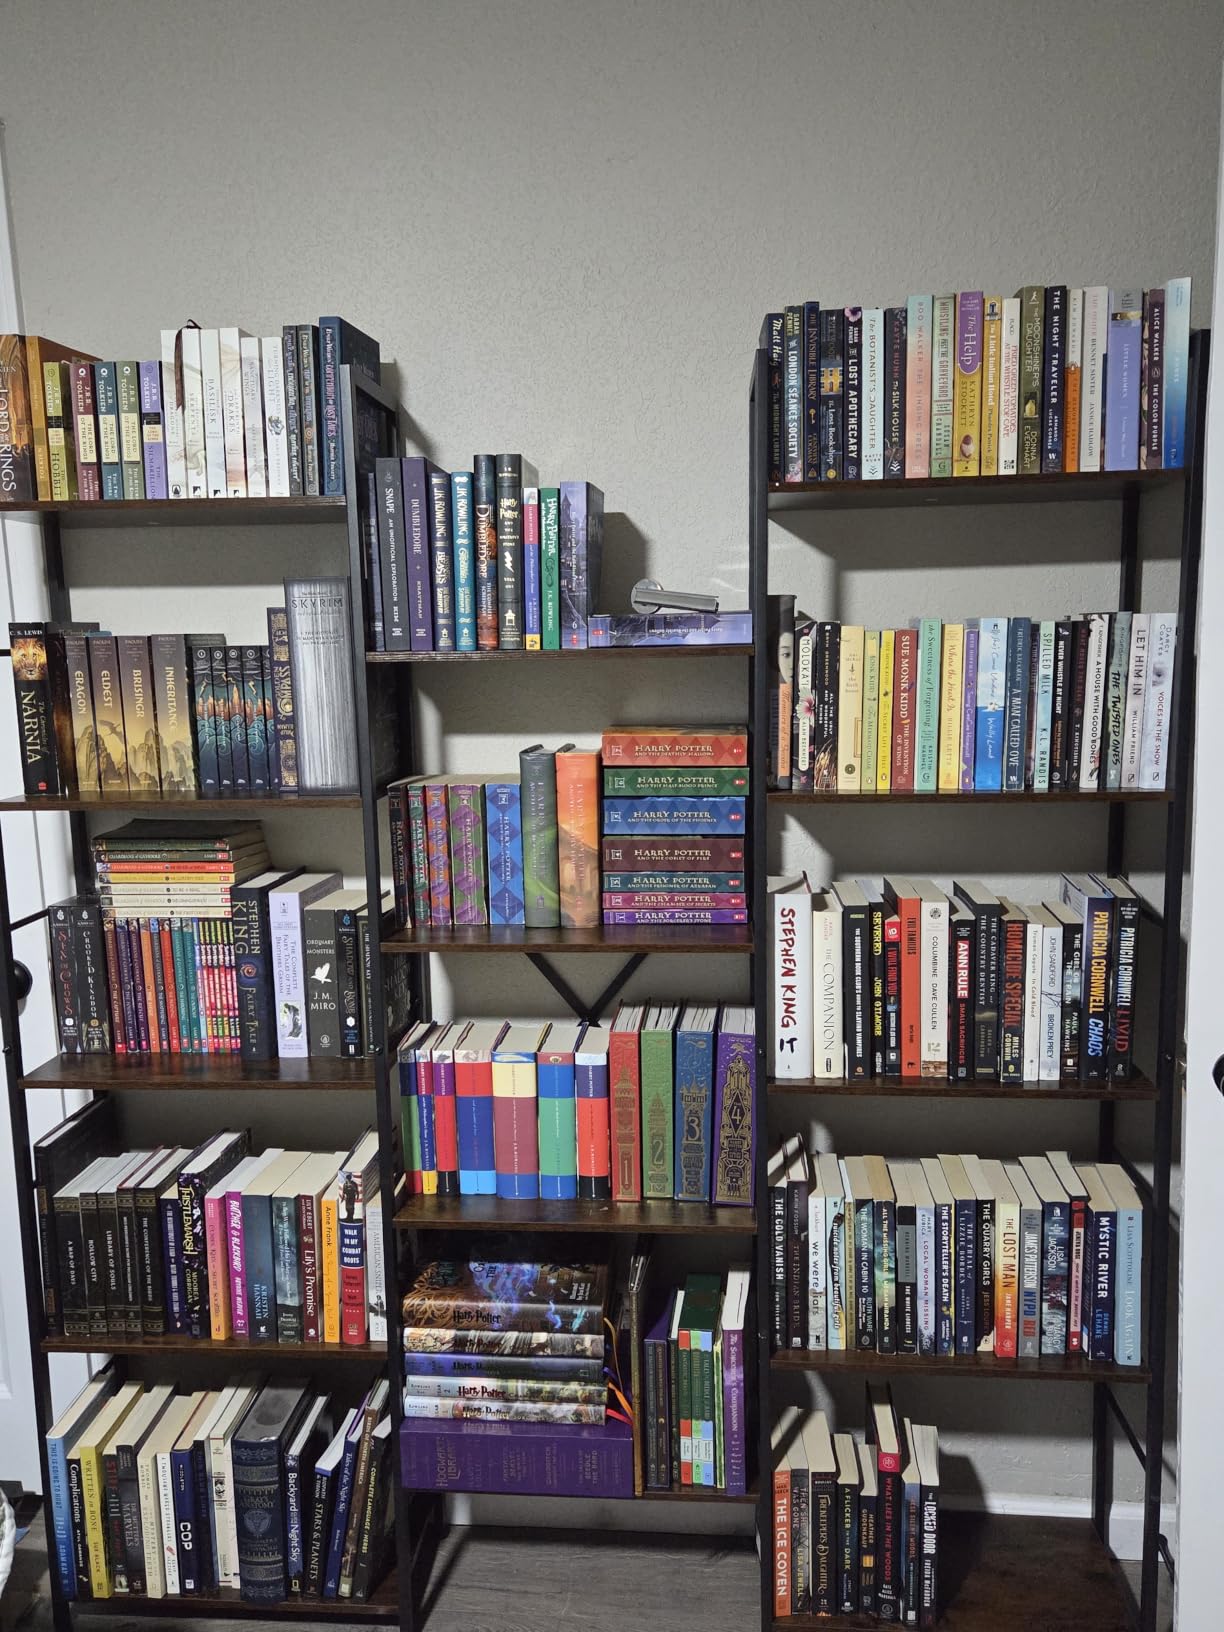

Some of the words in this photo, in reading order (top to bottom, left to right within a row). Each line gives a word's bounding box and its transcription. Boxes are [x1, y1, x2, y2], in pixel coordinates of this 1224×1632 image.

[773, 318, 782, 342] Matt
[967, 314, 976, 331] The
[808, 328, 818, 366] INVISIBLE
[961, 333, 976, 364] Help
[808, 369, 816, 400] LIBRARY
[849, 360, 857, 385] LOST
[789, 422, 797, 458] SOCIETY
[848, 390, 857, 458] APOTHECARY
[1, 444, 16, 491] RINGS
[52, 453, 62, 497] HOBBIT
[386, 488, 394, 513] SNAPE
[410, 499, 421, 554] DUMBLEDORE
[435, 500, 446, 536] ROWLING
[476, 504, 490, 578] DUMBLEDORE
[437, 551, 446, 584] BEASTS
[901, 636, 909, 656] SUE
[1043, 633, 1052, 669] SPILLED
[1136, 630, 1146, 650] LET
[1112, 671, 1120, 689] THE
[1134, 656, 1144, 678] HIM
[75, 670, 87, 714] ERAGON
[102, 670, 112, 708] ELDEST
[133, 670, 144, 718] BRISINGR
[1042, 674, 1051, 694] MILK
[1133, 684, 1142, 696] IN
[900, 692, 908, 718] KIDD
[1011, 697, 1021, 716] MAN
[1112, 694, 1121, 737] TWISTED
[22, 691, 40, 764] NARNIA
[1010, 719, 1020, 748] CALLED
[1009, 751, 1019, 766] OVE
[1038, 751, 1048, 784] RANDIS
[1112, 740, 1120, 765] ONES
[233, 901, 248, 954] KING
[249, 901, 260, 954] STEPHEN
[780, 908, 796, 977] STEPHEN
[873, 912, 882, 956] SEVERED
[1092, 912, 1108, 956] PATRICIA
[958, 942, 968, 968] ANN
[1006, 924, 1023, 978] HOMICIDE
[1119, 928, 1135, 963] PATRICIA
[958, 970, 968, 998] RULE
[1089, 958, 1106, 1014] CORNWELL
[1117, 966, 1132, 1006] CORNWELL
[240, 986, 255, 1016] FAIRY
[781, 984, 798, 1028] KING
[824, 963, 834, 1050] COMPANION
[1005, 982, 1022, 1028] SPECIAL
[246, 1020, 258, 1043] TALE
[1088, 1018, 1104, 1056] CHAOS
[1115, 1010, 1130, 1052] LIVID
[688, 1116, 701, 1140] 3
[654, 1140, 664, 1164] 2
[182, 1184, 198, 1254] THISTLEMARSH
[774, 1199, 783, 1216] THE
[775, 1219, 783, 1242] COLD
[1003, 1232, 1016, 1260] LOST
[1024, 1232, 1036, 1254] JAMES
[1100, 1217, 1110, 1258] MYSTIC
[302, 1250, 315, 1272] Lily's
[776, 1245, 784, 1280] VANISH
[812, 1242, 820, 1256] we
[1003, 1264, 1015, 1288] MAN
[1024, 1254, 1036, 1288] PATTERSON
[1098, 1263, 1108, 1298] RIVER
[254, 1284, 262, 1318] HANNAH
[306, 1276, 315, 1316] Promise
[1024, 1291, 1036, 1316] NYPD
[453, 1311, 474, 1322] Harry
[476, 1312, 500, 1323] Potter
[458, 1386, 480, 1396] Harry
[481, 1386, 506, 1398] Potter
[730, 1388, 738, 1431] COMPANION
[70, 1464, 82, 1522] Complications
[288, 1472, 298, 1512] Backyard
[314, 1502, 324, 1530] STARS
[776, 1498, 786, 1526] THE
[818, 1494, 830, 1542] FIREKEEPER'S
[924, 1502, 936, 1531] LOCKED
[181, 1522, 192, 1550] COP
[290, 1524, 298, 1546] Night
[777, 1528, 786, 1549] ICE
[924, 1533, 936, 1554] DOOR
[290, 1548, 300, 1561] Sky
[309, 1542, 320, 1580] PLANETS
[816, 1544, 830, 1595] DAUGHTER
[778, 1552, 787, 1596] COVEN
